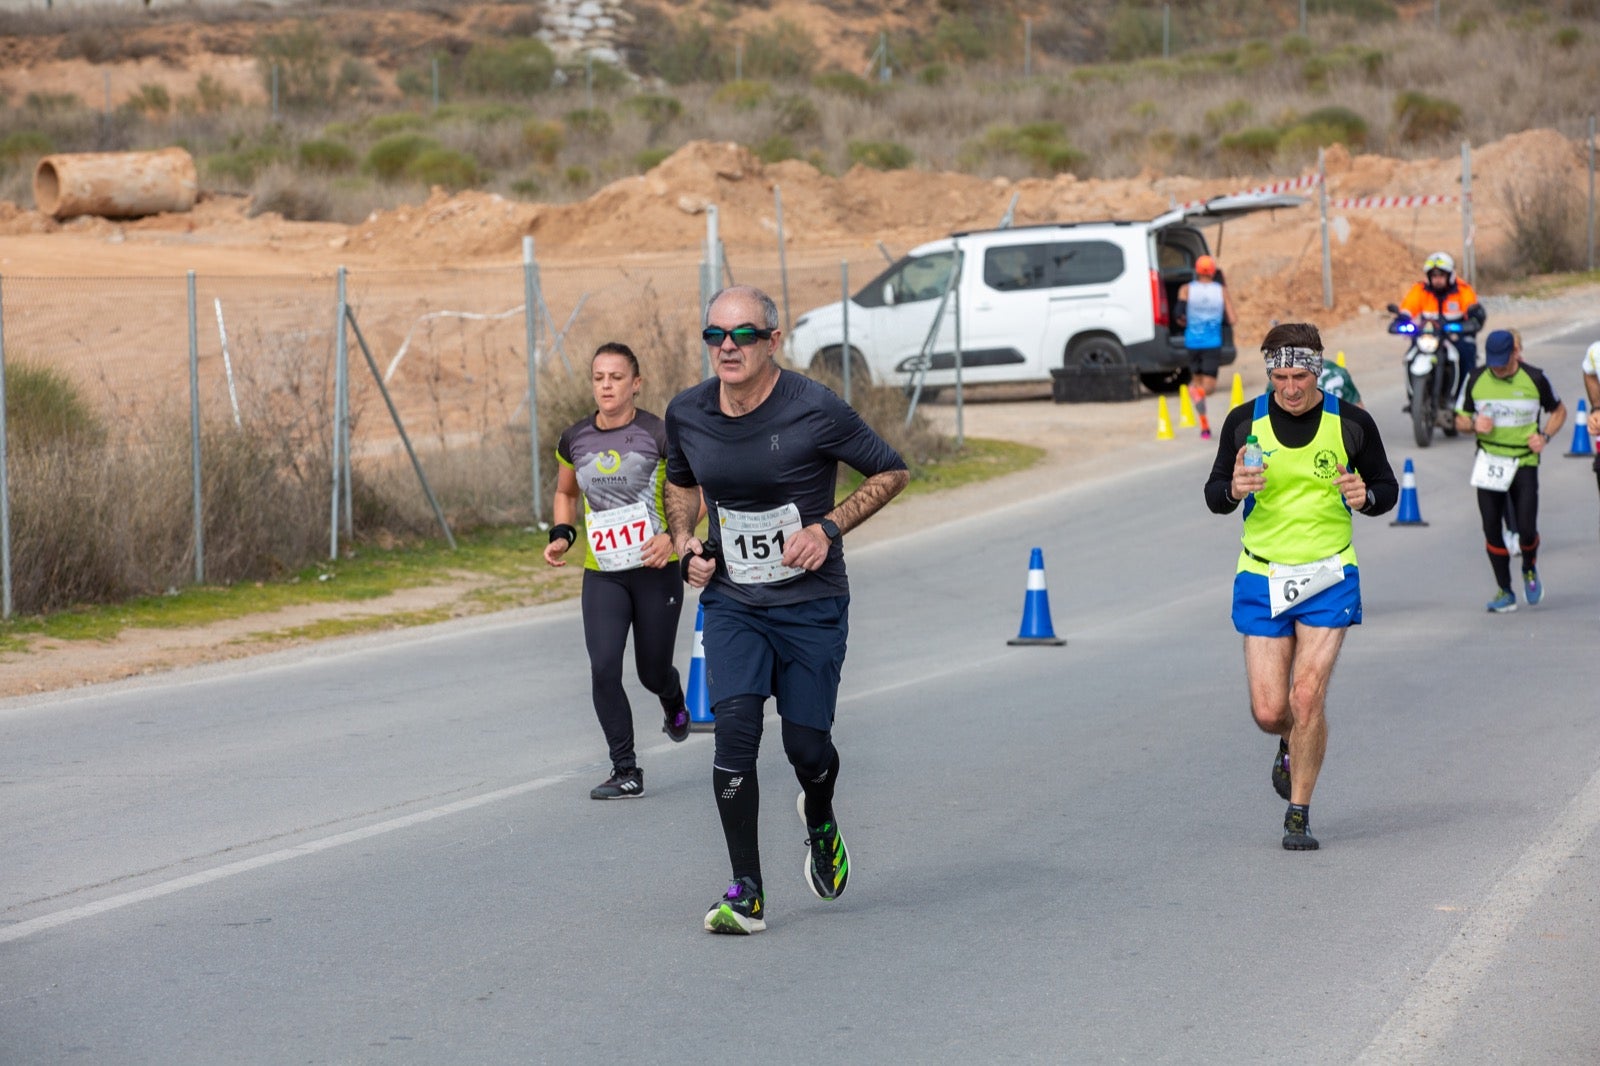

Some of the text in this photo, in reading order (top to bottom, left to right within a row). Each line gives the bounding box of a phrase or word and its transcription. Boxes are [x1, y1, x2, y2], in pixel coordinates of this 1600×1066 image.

[1487, 465, 1504, 478] 53
[592, 520, 646, 552] 2117
[734, 529, 785, 560] 151
